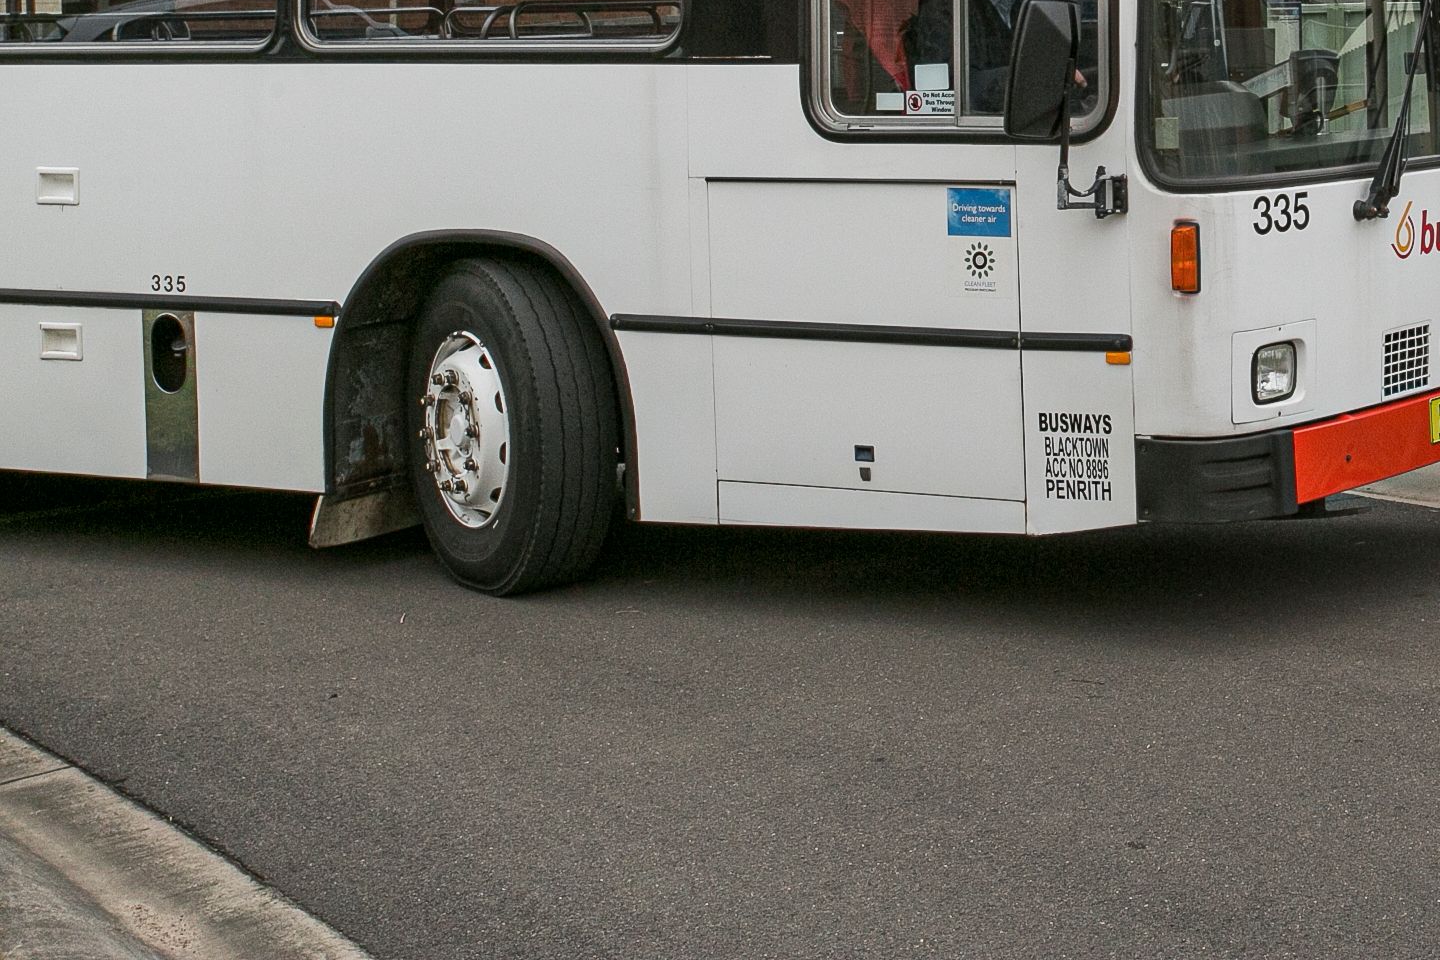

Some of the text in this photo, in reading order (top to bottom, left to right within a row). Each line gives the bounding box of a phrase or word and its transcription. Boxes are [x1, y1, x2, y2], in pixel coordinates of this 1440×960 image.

[952, 203, 1006, 215] Driving towards
[961, 214, 997, 223] cleaner air
[1252, 191, 1310, 236] 335
[151, 274, 186, 293] 335
[1038, 412, 1112, 435] BUSWAYS
[1044, 436, 1109, 459] BLACKTOWN
[1045, 457, 1109, 480] ACC NO 8896
[1045, 479, 1112, 501] PENRITH
